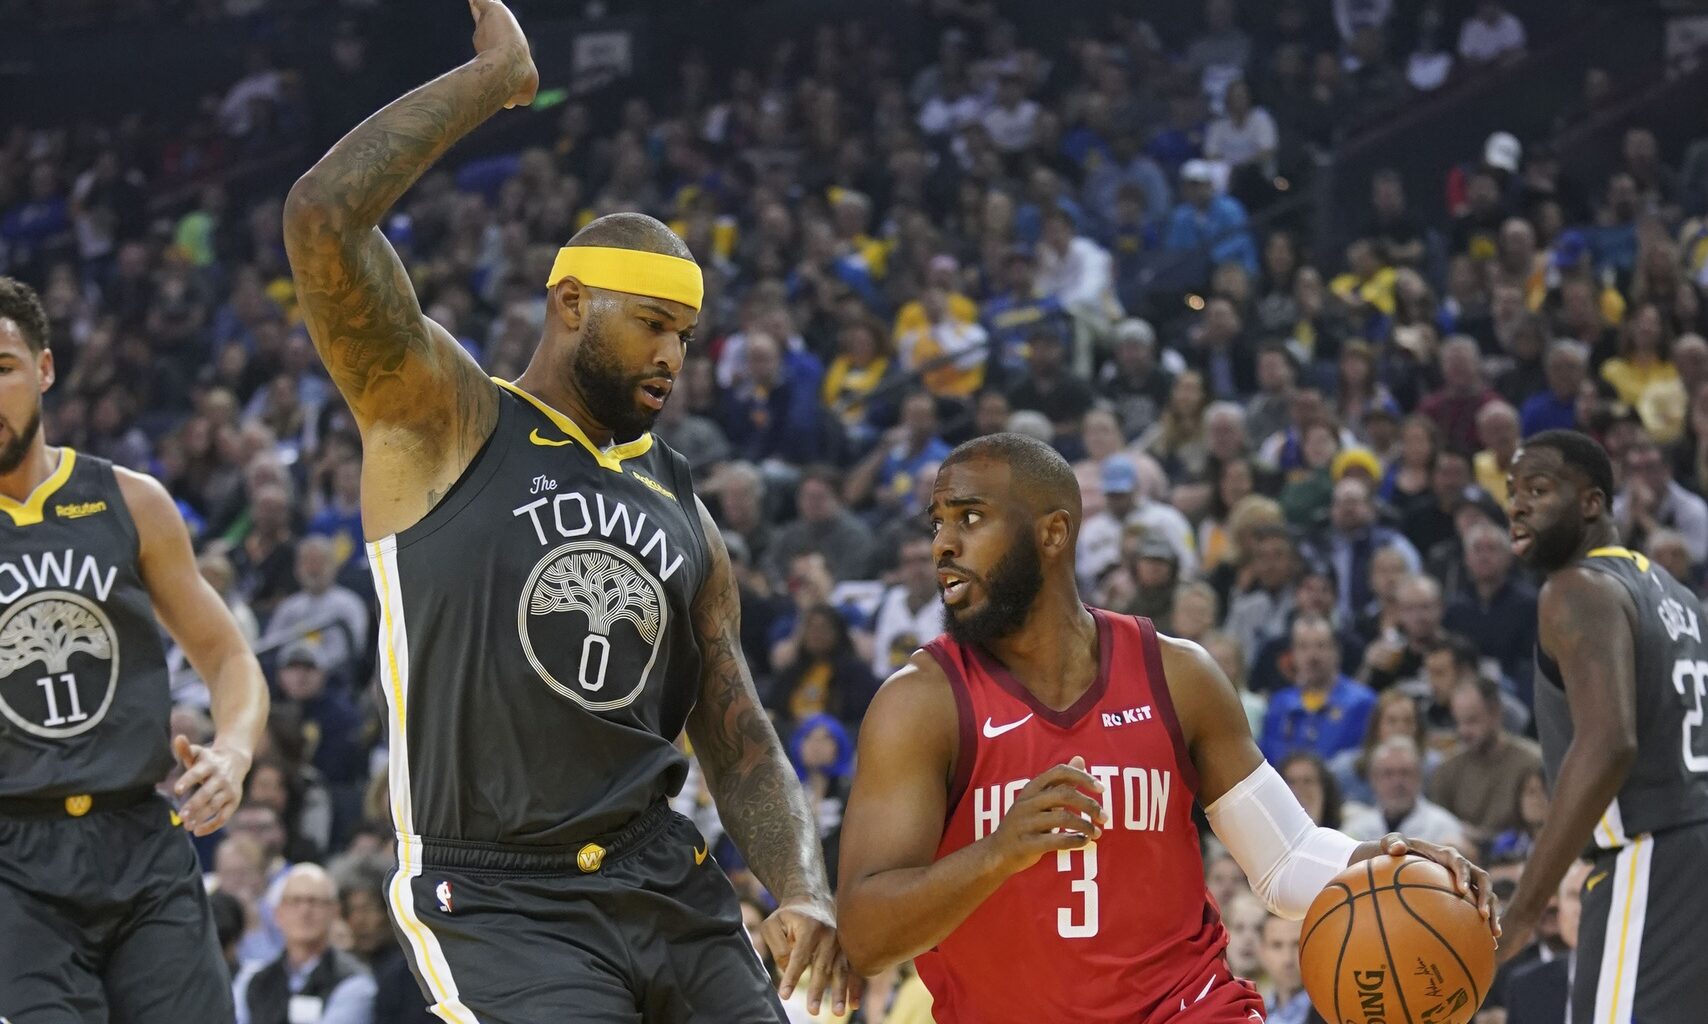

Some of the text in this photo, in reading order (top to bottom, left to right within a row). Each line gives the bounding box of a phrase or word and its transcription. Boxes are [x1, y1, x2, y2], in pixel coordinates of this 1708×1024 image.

[530, 474, 558, 494] The
[512, 492, 684, 582] TOWN
[578, 633, 611, 692] 0
[37, 673, 88, 727] 11
[974, 765, 1171, 842] HTON
[1057, 840, 1099, 939] 3
